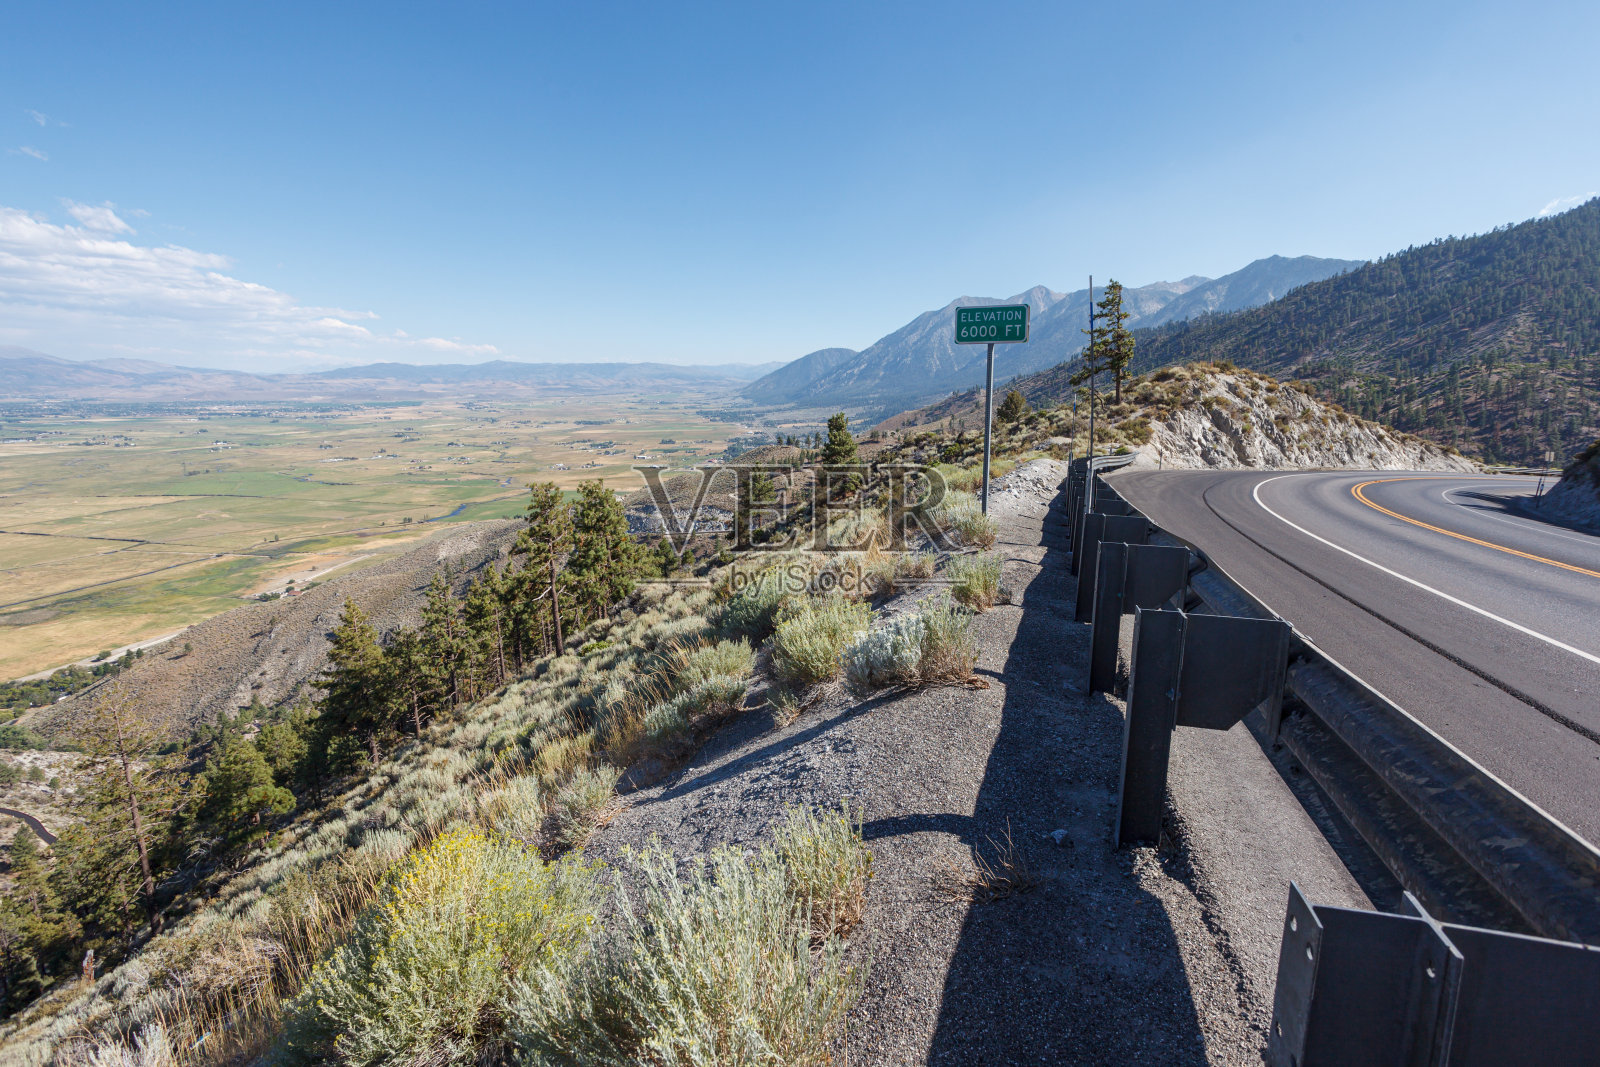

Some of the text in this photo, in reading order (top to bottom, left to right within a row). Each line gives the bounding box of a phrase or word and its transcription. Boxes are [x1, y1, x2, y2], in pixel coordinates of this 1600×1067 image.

[961, 310, 1022, 322] ELEVATION
[961, 324, 1022, 337] 6000 FT
